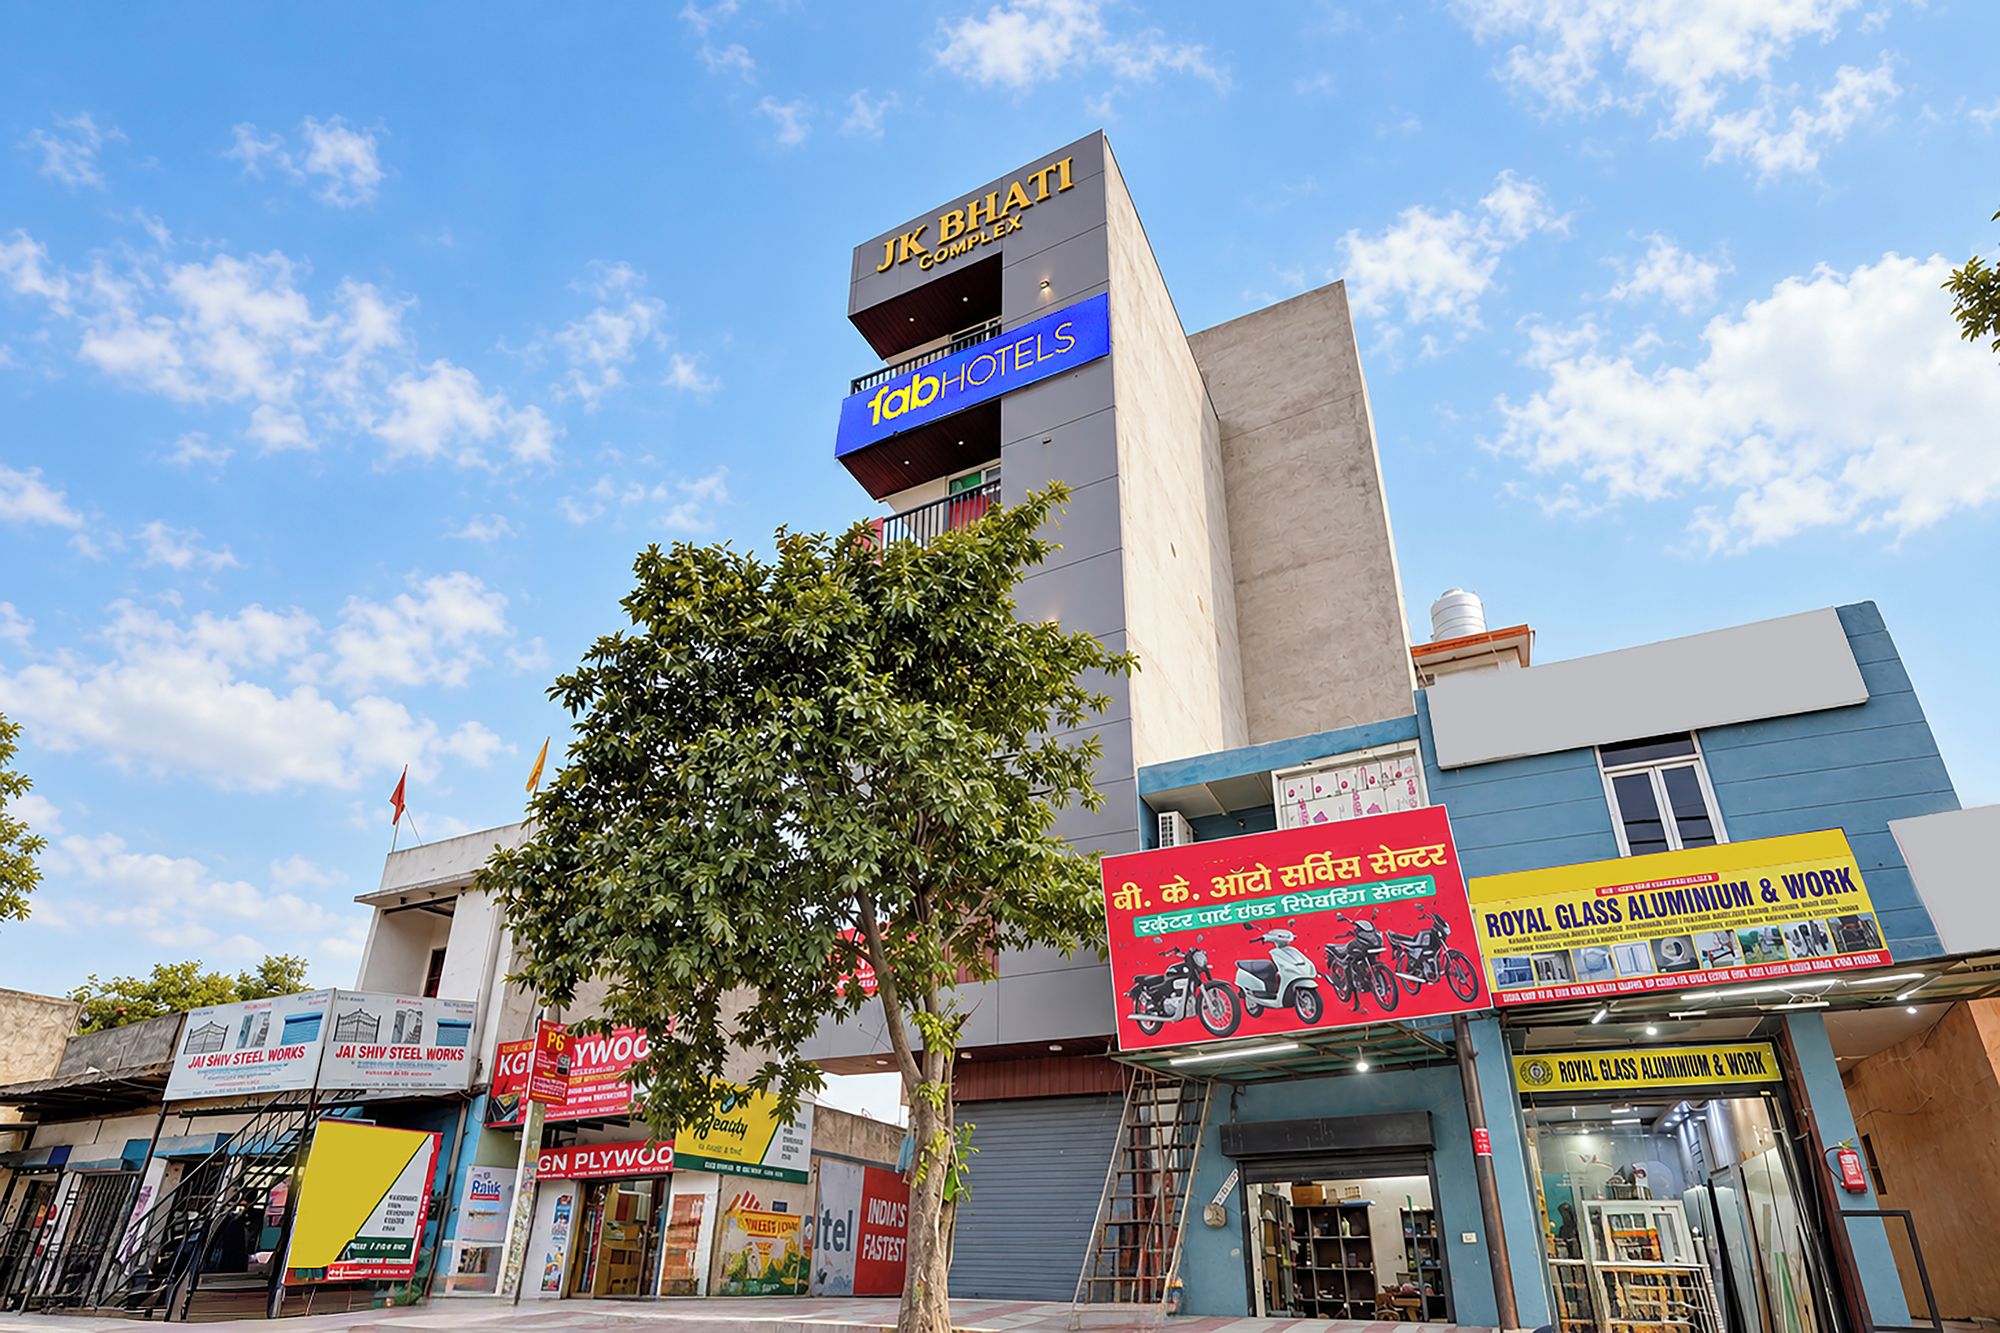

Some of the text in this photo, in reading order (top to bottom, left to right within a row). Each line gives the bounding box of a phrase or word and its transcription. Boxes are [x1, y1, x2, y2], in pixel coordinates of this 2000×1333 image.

[876, 156, 1074, 273] JK BHATI
[919, 213, 1023, 270] COMPLEX
[1112, 882, 1151, 910] बी.
[1159, 875, 1200, 903] के.
[1210, 862, 1272, 897] ऑटो
[1278, 851, 1362, 887] सर्विस
[1485, 907, 1552, 938] ROYAL
[1555, 898, 1622, 930] GLASS
[1627, 881, 1754, 921] ALUMINIUM
[1759, 878, 1780, 903] &
[1781, 867, 1858, 899] WORK
[188, 1057, 205, 1069] JAI
[207, 1054, 232, 1067] SHIV
[233, 1051, 264, 1065] STEEL
[268, 1046, 306, 1061] WORKS
[335, 1045, 464, 1061] JAI SHIV STEEL WORKS
[1558, 1060, 1599, 1083] ROYAL
[1599, 1058, 1638, 1081] GLASS
[1641, 1054, 1709, 1079] ALUMINIUM
[1713, 1053, 1725, 1076] &
[1727, 1051, 1767, 1075] WORK
[538, 1154, 568, 1172] GN
[575, 1146, 673, 1170] PLYWOO
[867, 1198, 907, 1228] INDIA'S
[862, 1234, 905, 1262] FASTEST
